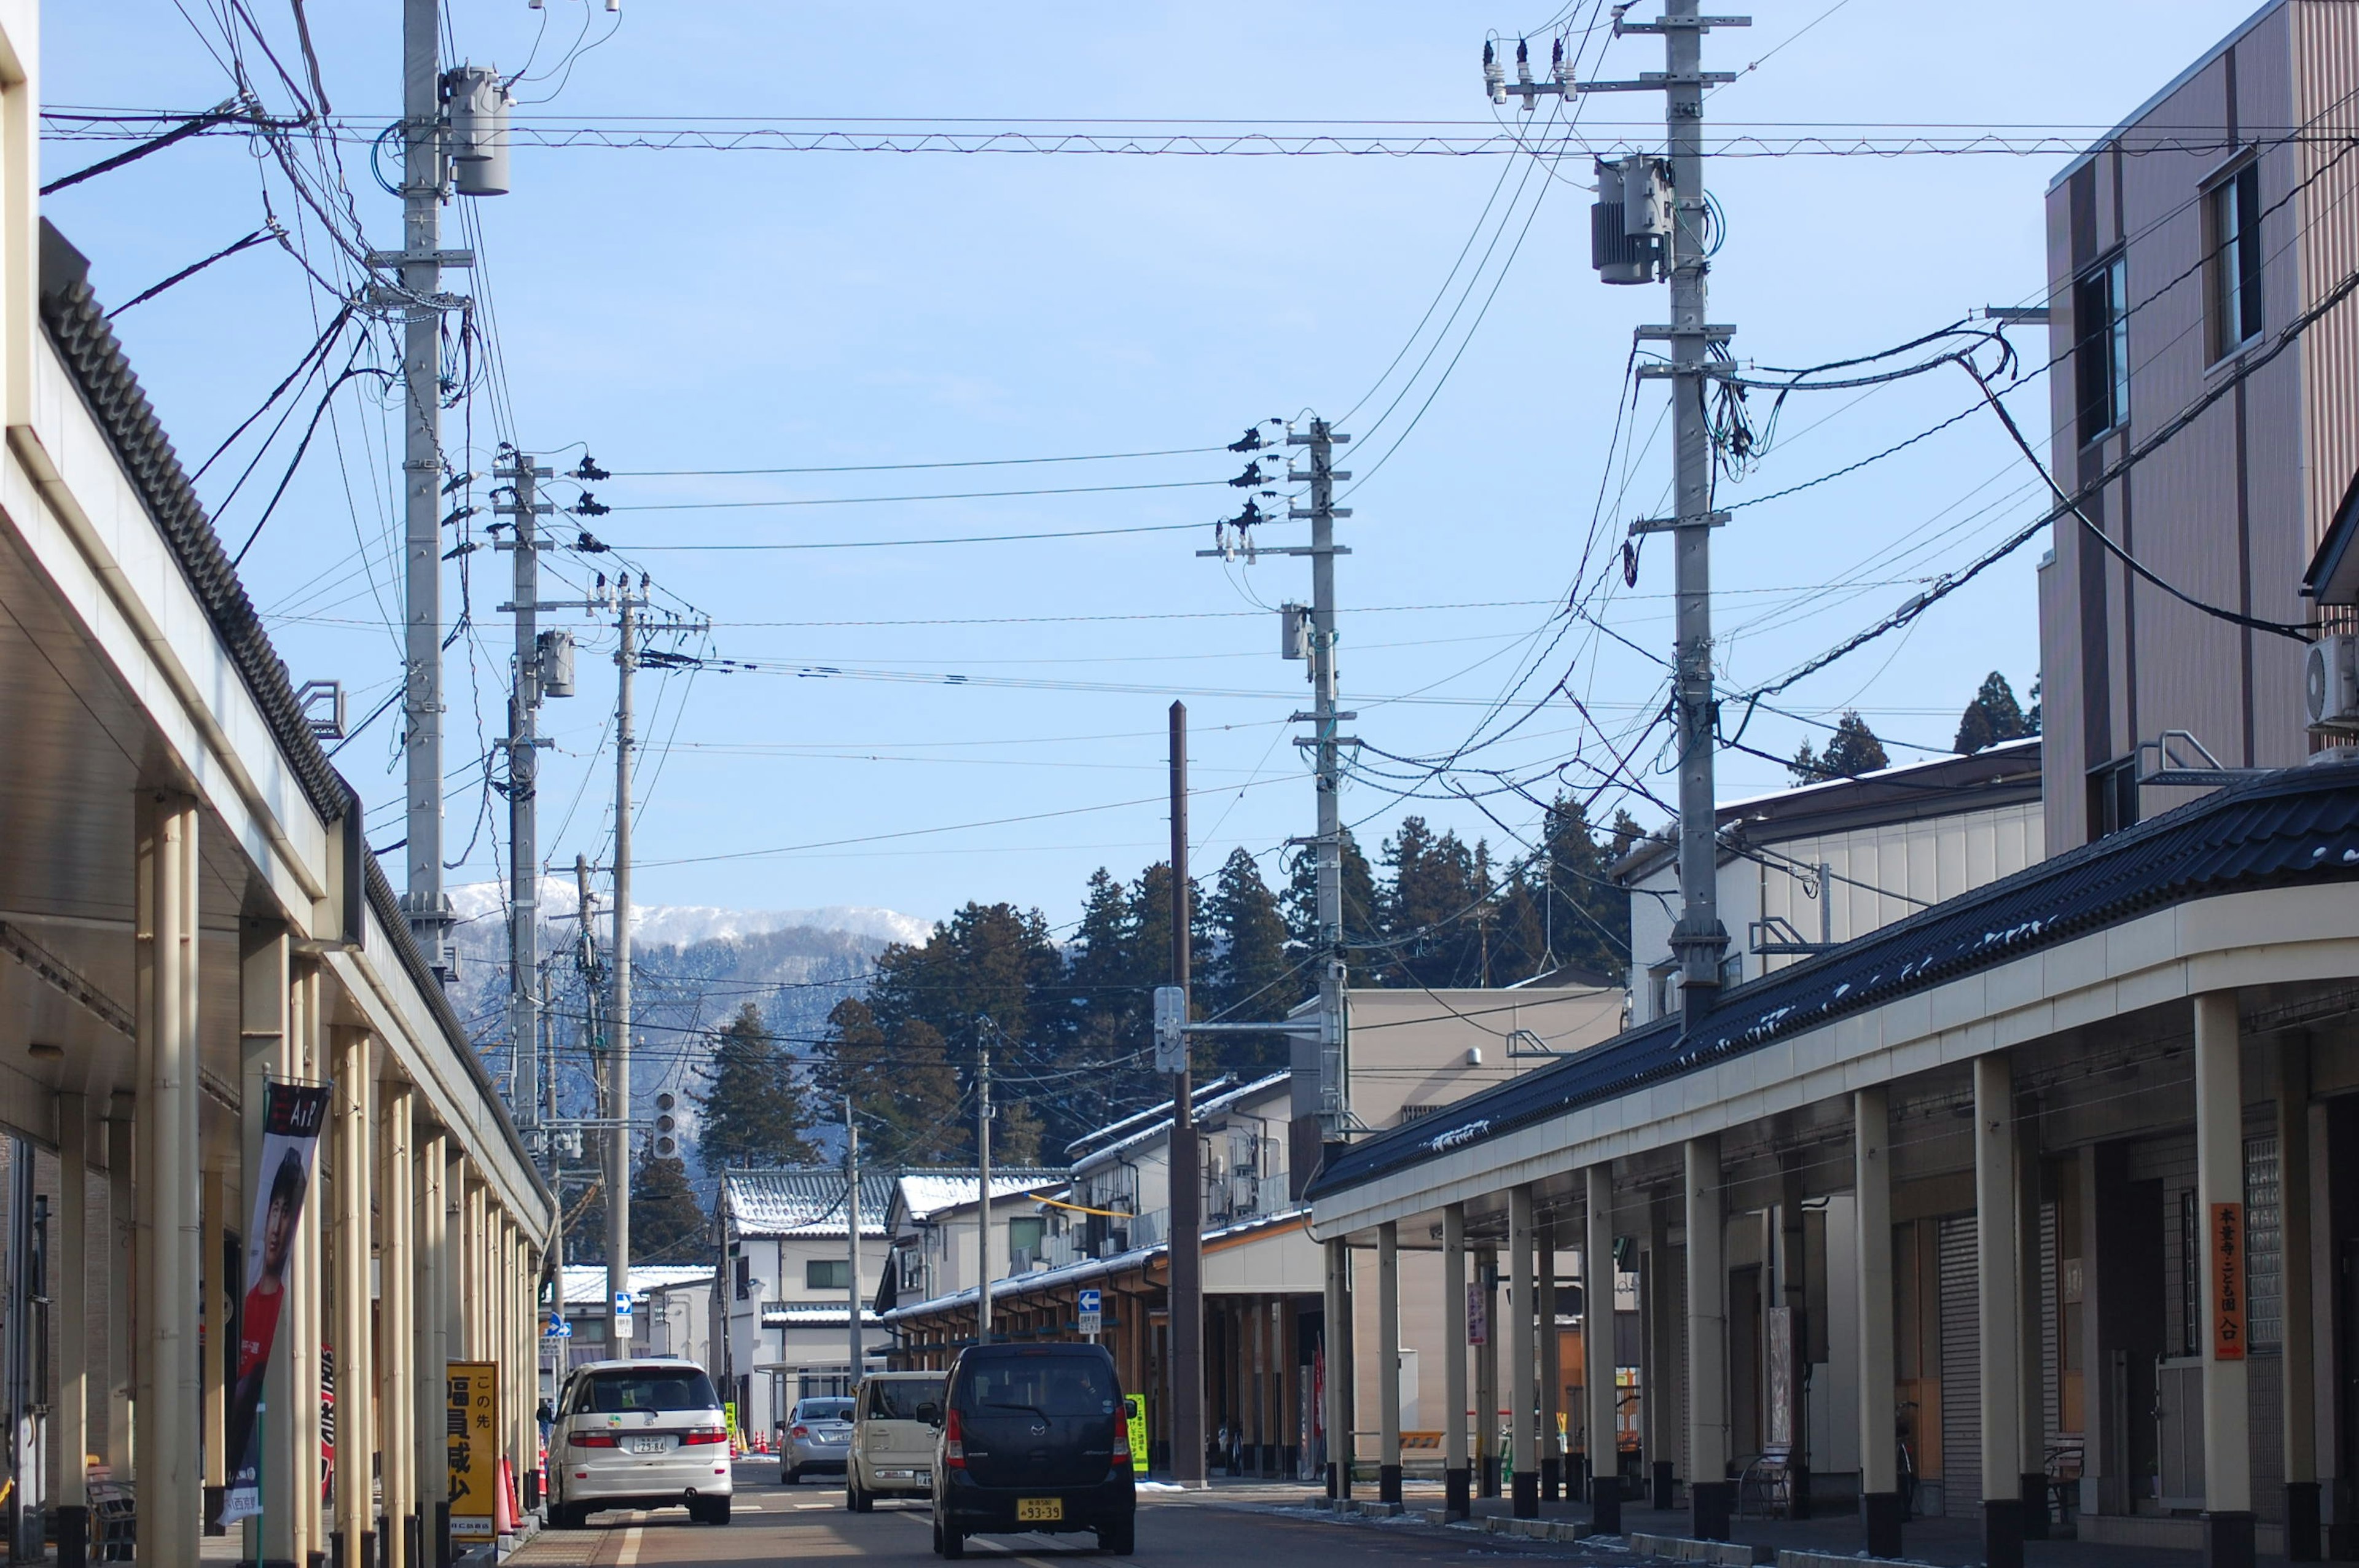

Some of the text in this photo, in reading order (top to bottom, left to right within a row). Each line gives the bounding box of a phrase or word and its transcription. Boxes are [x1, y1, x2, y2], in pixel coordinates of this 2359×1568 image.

[2220, 1317, 2238, 1340] 入口
[476, 1376, 490, 1428] この先
[1028, 1507, 1060, 1519] 93-39
